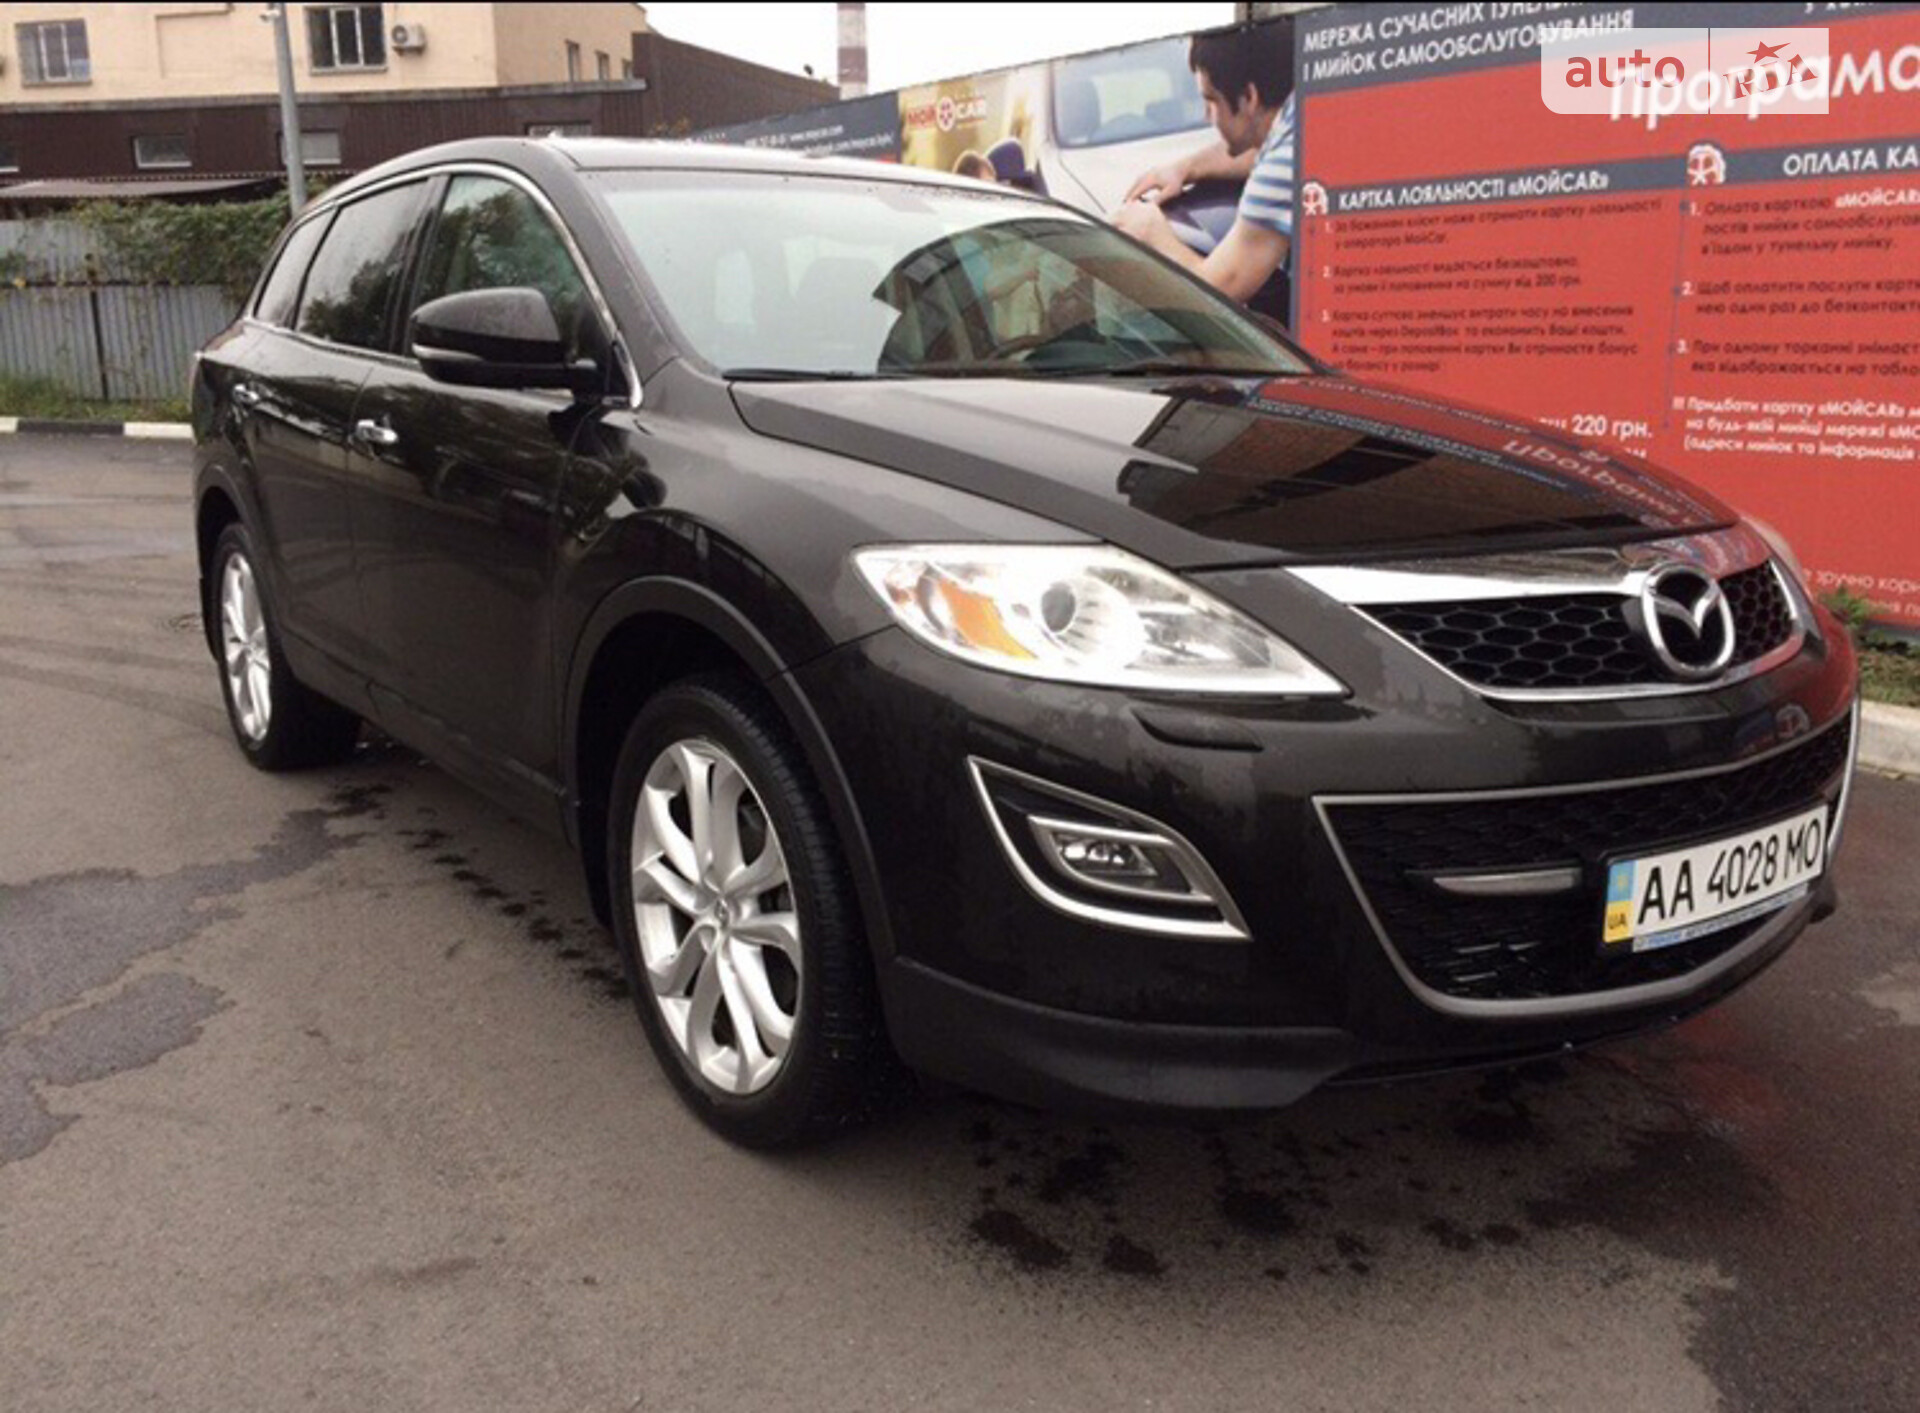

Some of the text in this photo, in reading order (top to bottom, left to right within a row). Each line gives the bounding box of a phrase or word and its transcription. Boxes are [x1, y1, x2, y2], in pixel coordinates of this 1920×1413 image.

[1304, 23, 1375, 51] МЕРЕЖА
[1380, 3, 1485, 39] СУЧАСНИХ
[1312, 50, 1375, 80] МИЙОК
[1380, 9, 1635, 70] САМООБСЛУГОВУВАННЯ
[1783, 148, 1878, 176] ОПЛАТА
[1338, 188, 1395, 211] КАРТКА
[1399, 178, 1505, 206] ЛОЯЛЬНОСТІ
[1572, 414, 1608, 436] 220
[1612, 420, 1653, 442] грн.
[1638, 859, 1695, 925] AA
[1708, 834, 1780, 903] 4028
[1784, 818, 1822, 879] MO
